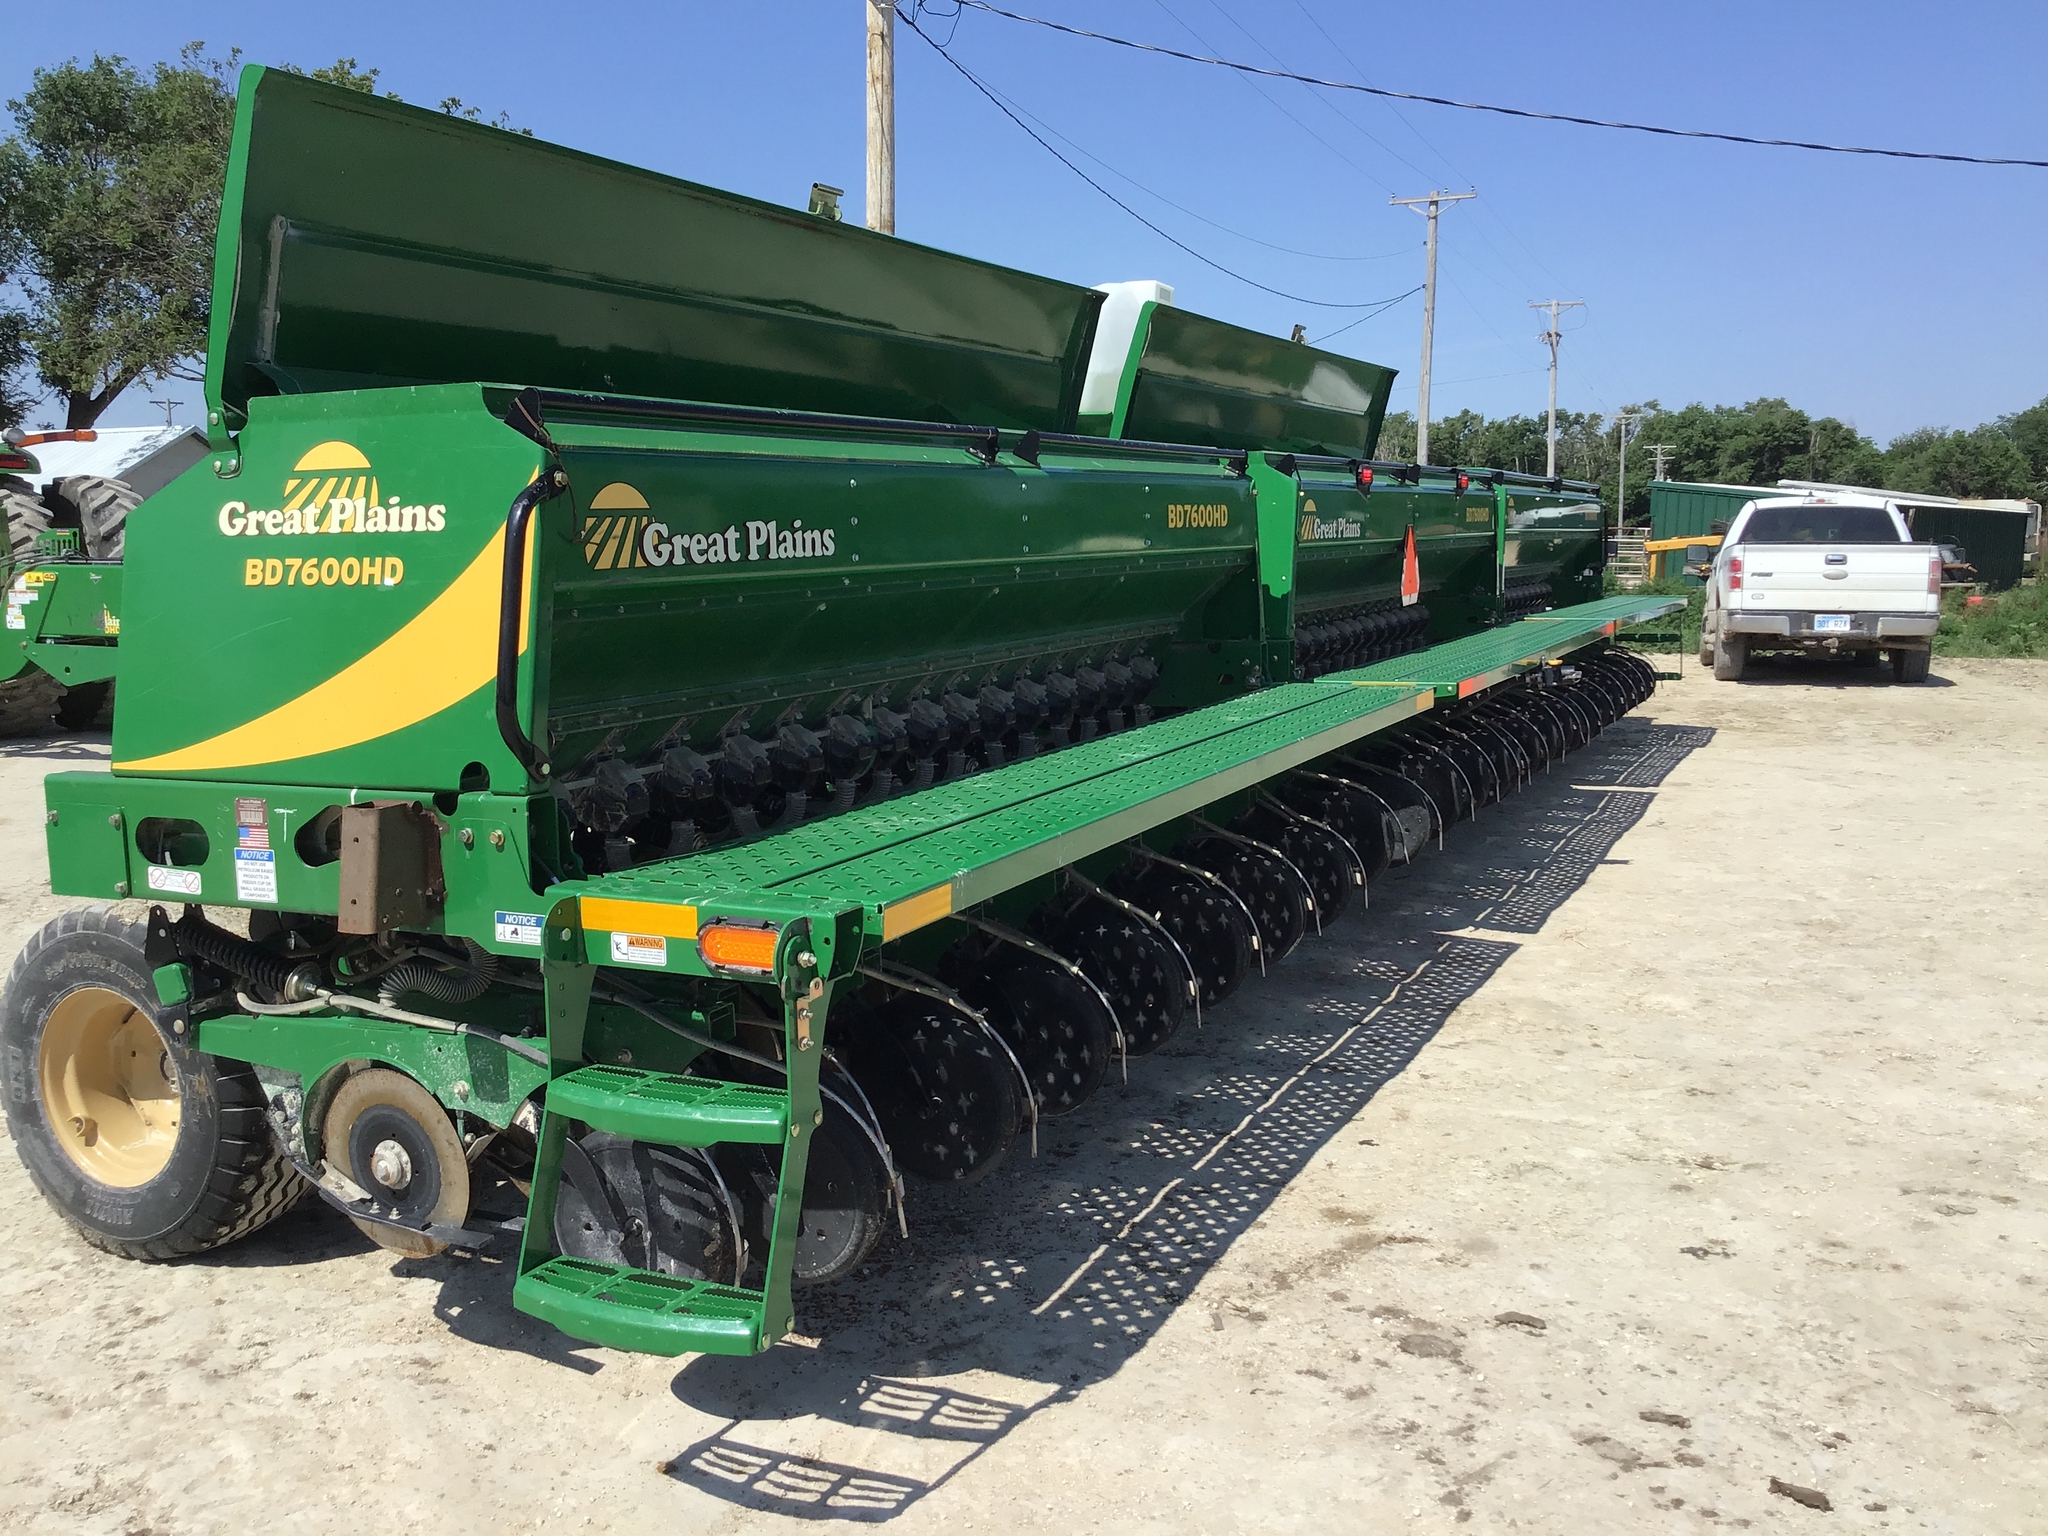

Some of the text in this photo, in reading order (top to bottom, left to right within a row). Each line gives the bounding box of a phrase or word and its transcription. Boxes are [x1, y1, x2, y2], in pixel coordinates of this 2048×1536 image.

[218, 495, 446, 537] Great Plains
[1167, 504, 1229, 529] BD7600HD
[1313, 515, 1361, 540] Great Plains
[642, 518, 836, 568] Great Plains
[244, 556, 405, 588] BD7600HD
[240, 850, 270, 860] NOTICE
[505, 914, 538, 926] NOTICE
[634, 937, 663, 948] WARNING
